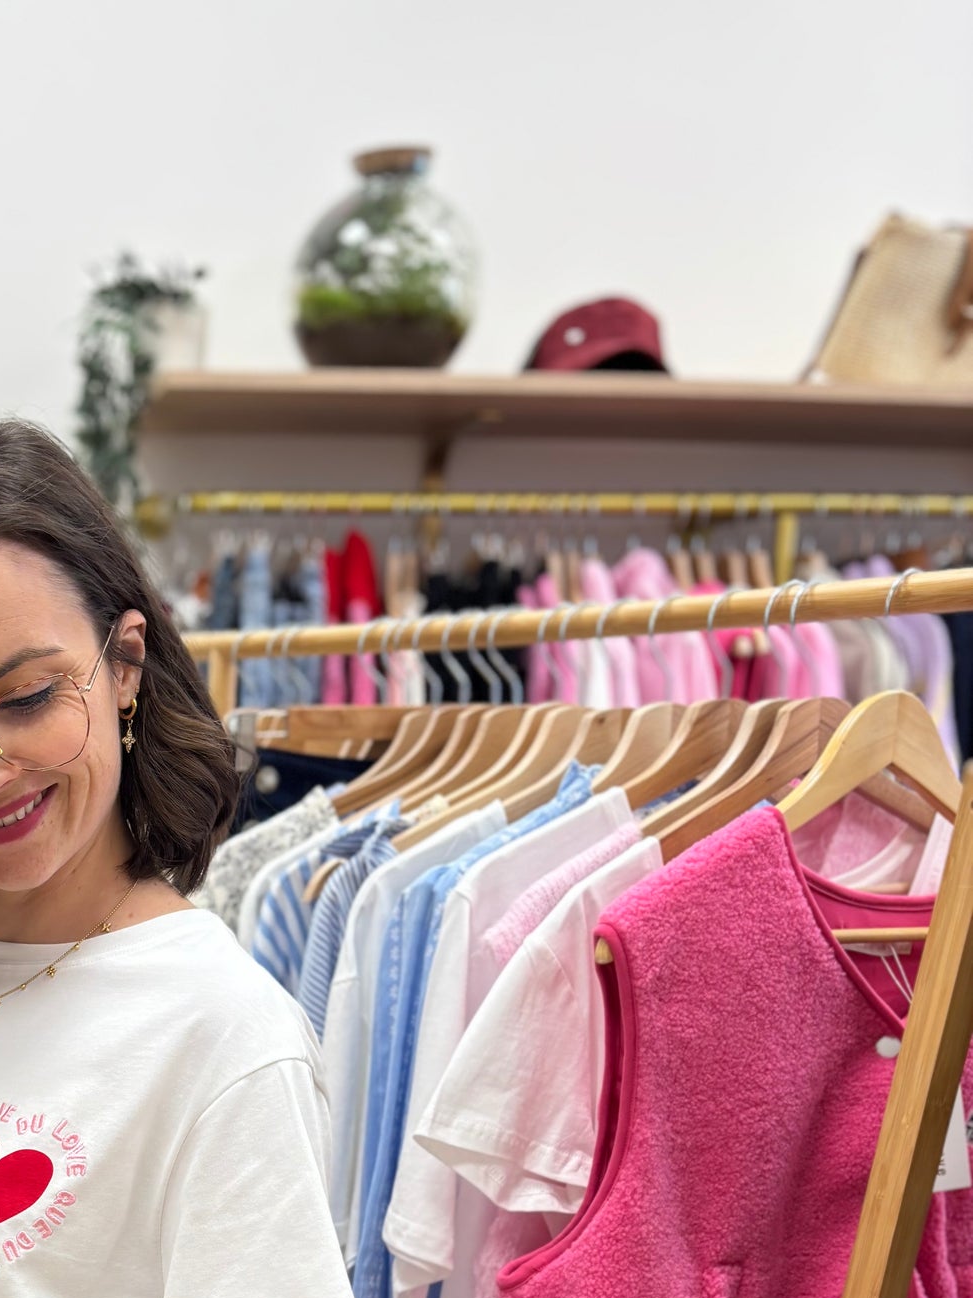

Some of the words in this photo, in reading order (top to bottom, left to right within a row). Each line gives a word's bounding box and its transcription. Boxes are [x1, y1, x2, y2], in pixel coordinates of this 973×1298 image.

[16, 1114, 44, 1135] DU
[51, 1119, 88, 1177] LOVE
[32, 1190, 77, 1239] QUE
[2, 1231, 35, 1262] DU
